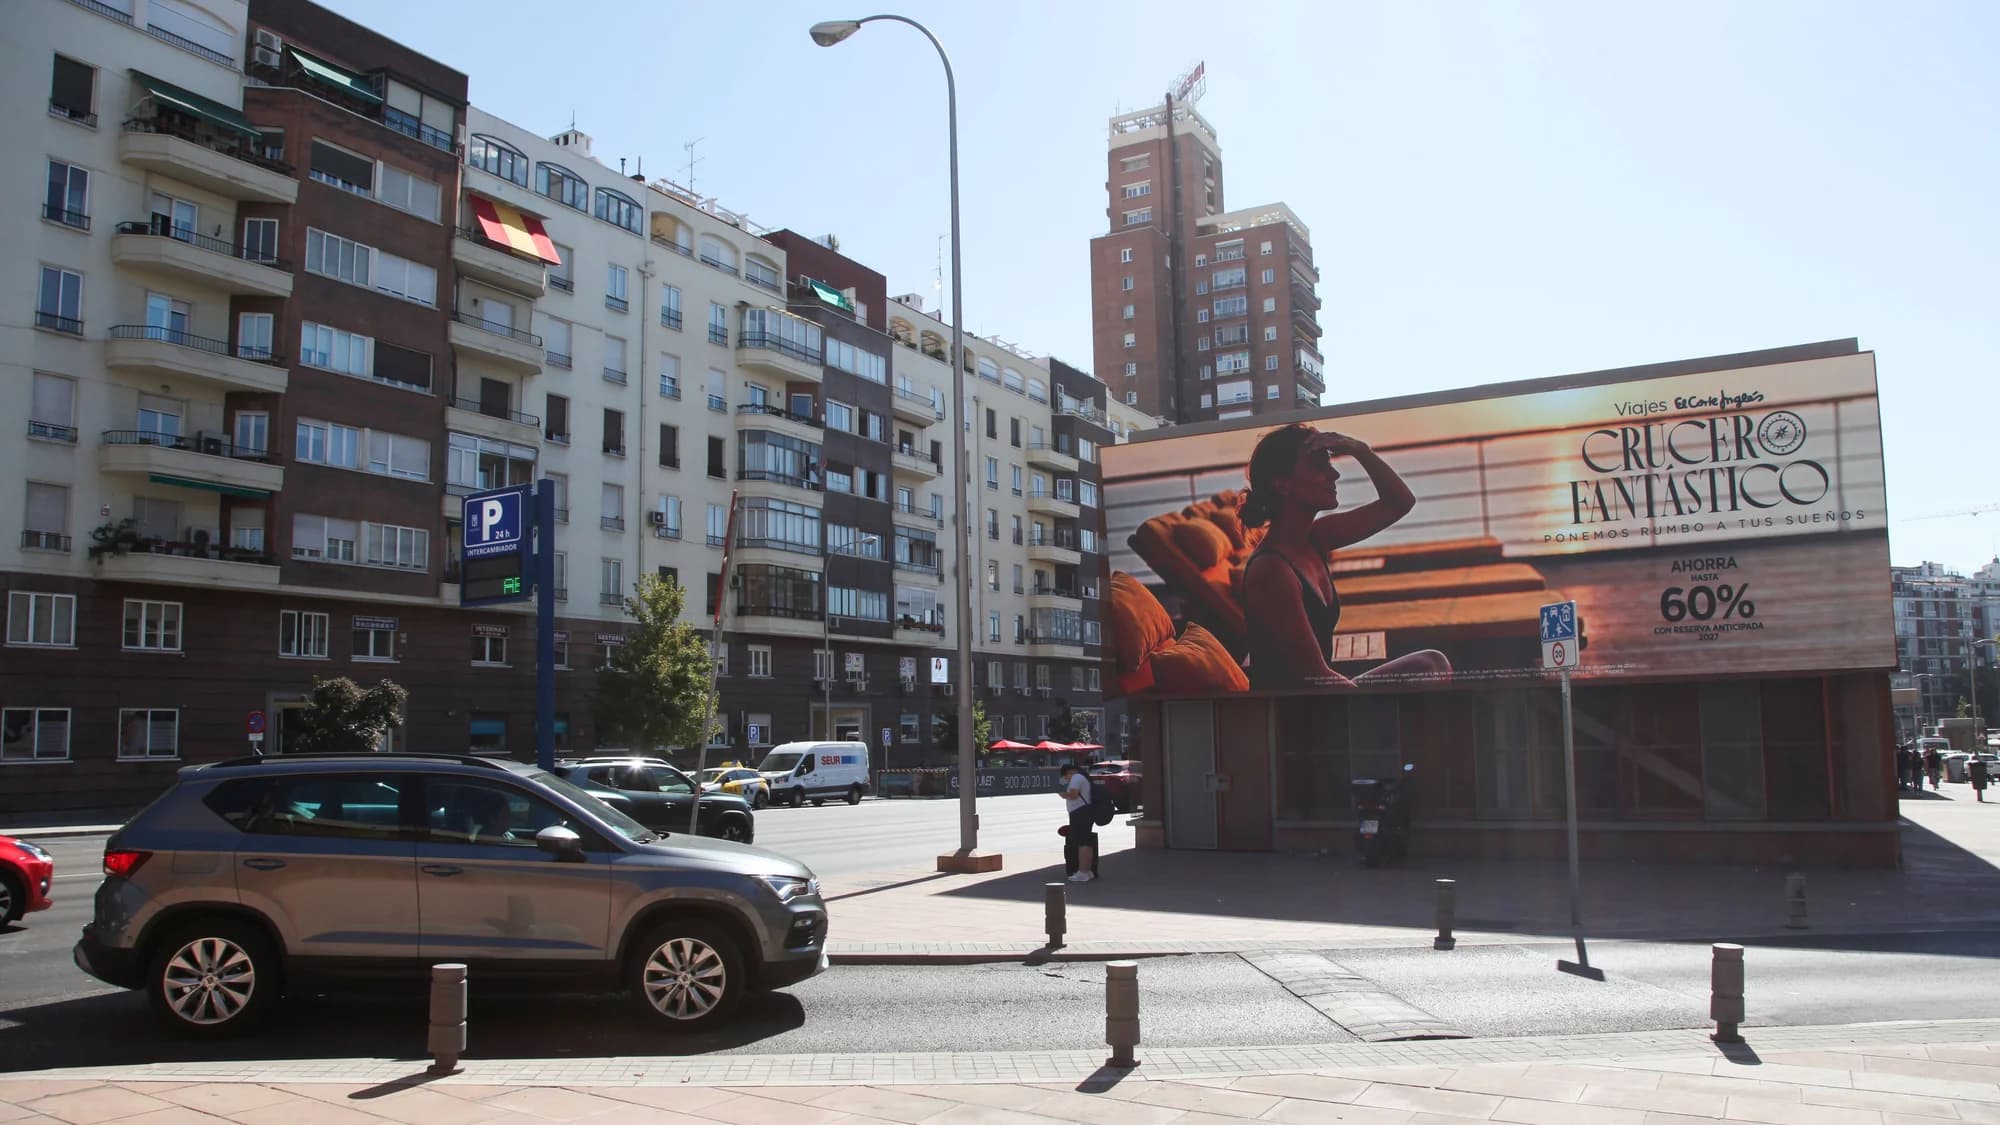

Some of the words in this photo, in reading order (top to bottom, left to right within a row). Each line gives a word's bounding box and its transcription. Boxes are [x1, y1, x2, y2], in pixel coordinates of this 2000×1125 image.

[1614, 401, 1668, 416] Viajes
[1688, 393, 1719, 408] Corte
[1568, 459, 1830, 525] FANTÁSTICO
[482, 499, 503, 541] P
[1543, 528, 1630, 543] PONEMOS
[1640, 522, 1704, 537] RUMBO
[1716, 521, 1727, 531] A
[1738, 516, 1773, 529] TUS
[1785, 509, 1866, 525] SUEÑOS
[467, 543, 517, 556] INTERCAMBIADOR
[1671, 557, 1738, 573] AHORRA
[1690, 573, 1719, 582] HASTA
[1660, 583, 1755, 622] 60%
[1654, 626, 1672, 635] CON
[1673, 624, 1711, 634] RESERVA
[1712, 622, 1764, 633] ANTICIPADA
[1698, 633, 1719, 641] 2027
[821, 755, 840, 766] SEUR
